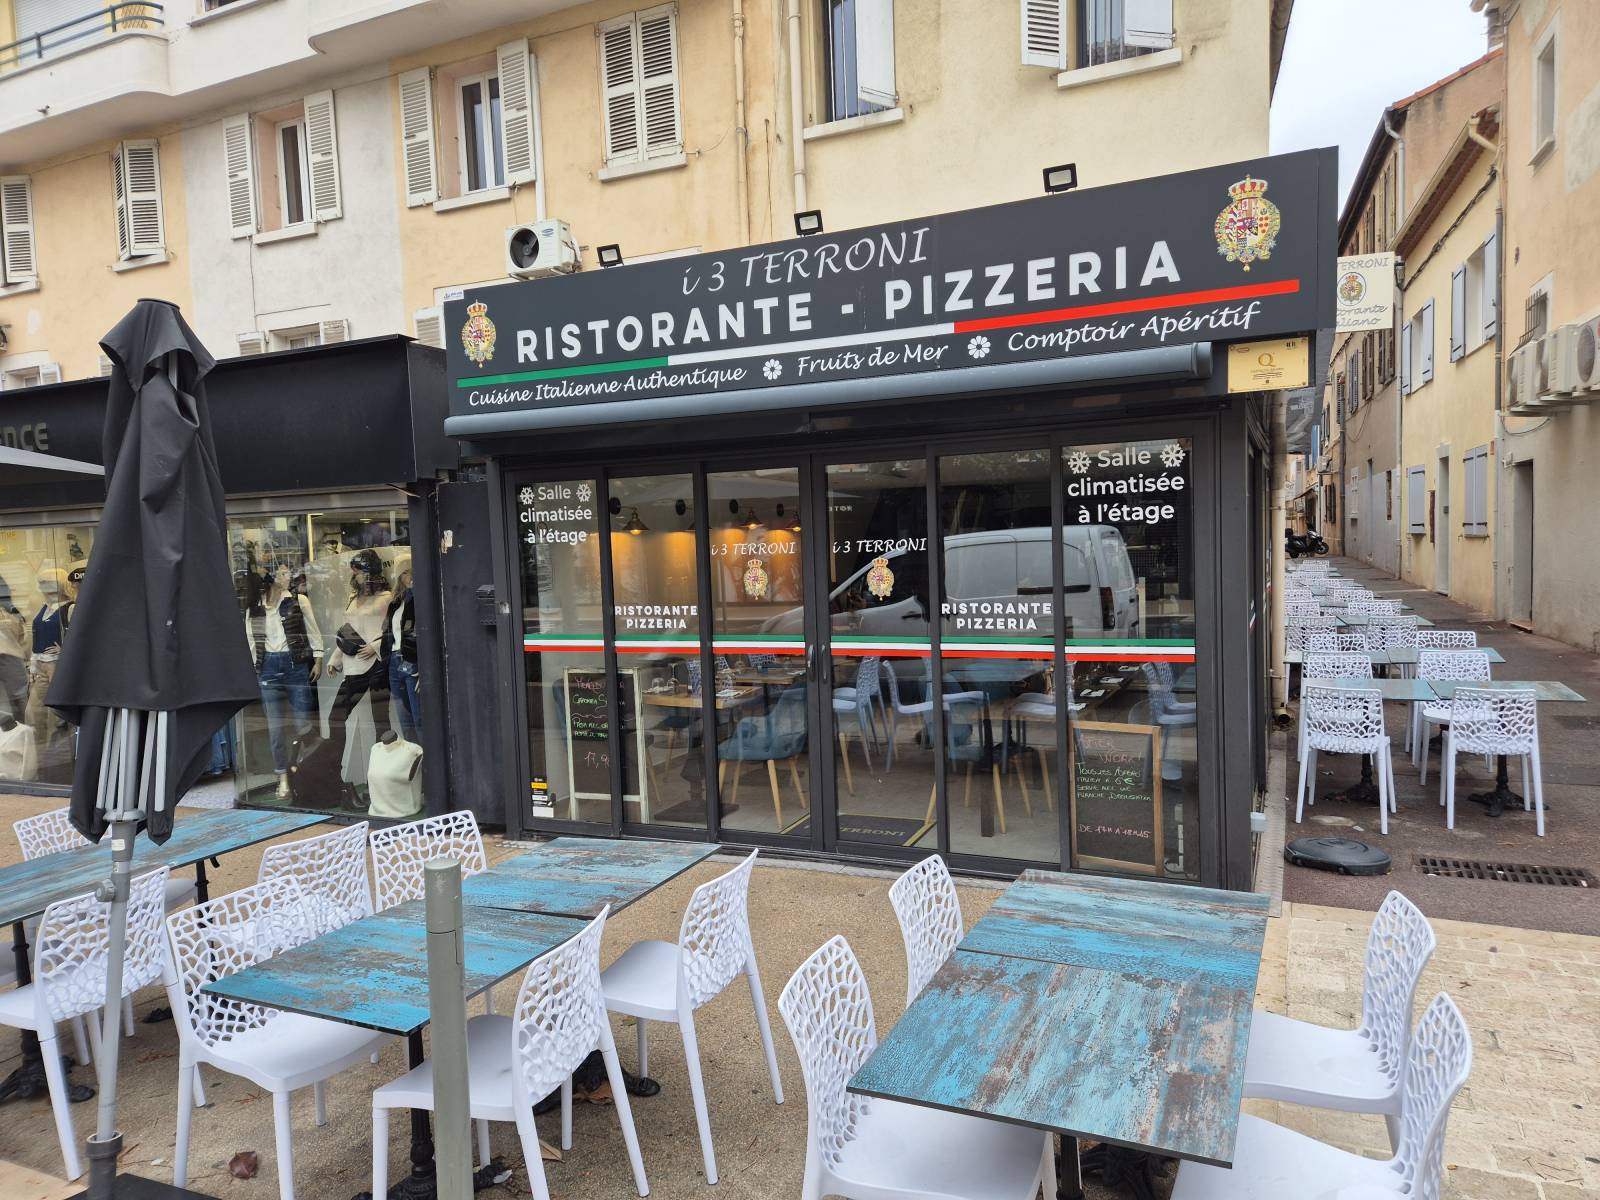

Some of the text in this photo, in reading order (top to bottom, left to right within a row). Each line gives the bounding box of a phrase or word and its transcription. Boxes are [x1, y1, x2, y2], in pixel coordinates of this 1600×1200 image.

[708, 261, 726, 292] 3
[739, 228, 931, 287] TERRONI
[516, 292, 812, 364] RISTORANTE
[885, 240, 1181, 320] PIZZERIA
[469, 301, 1262, 407] Cuisine Italienne Authentique Fruits de Mer Comptoir Apéritif
[1097, 446, 1151, 468] Salle
[1067, 471, 1185, 497] climatisée
[538, 486, 571, 501] Salle
[520, 506, 593, 523] climatisée
[1078, 502, 1175, 524] à l'étage
[527, 528, 587, 546] à l'étage
[842, 540, 851, 554] 3
[855, 537, 928, 553] TERRONI
[720, 543, 728, 556] 3
[732, 541, 797, 555] TERRONI
[614, 605, 698, 616] RISTORANTE
[941, 602, 1053, 615] RISTORANTE
[626, 618, 687, 629] PIZZERIA
[956, 616, 1038, 630] PIZZERIA
